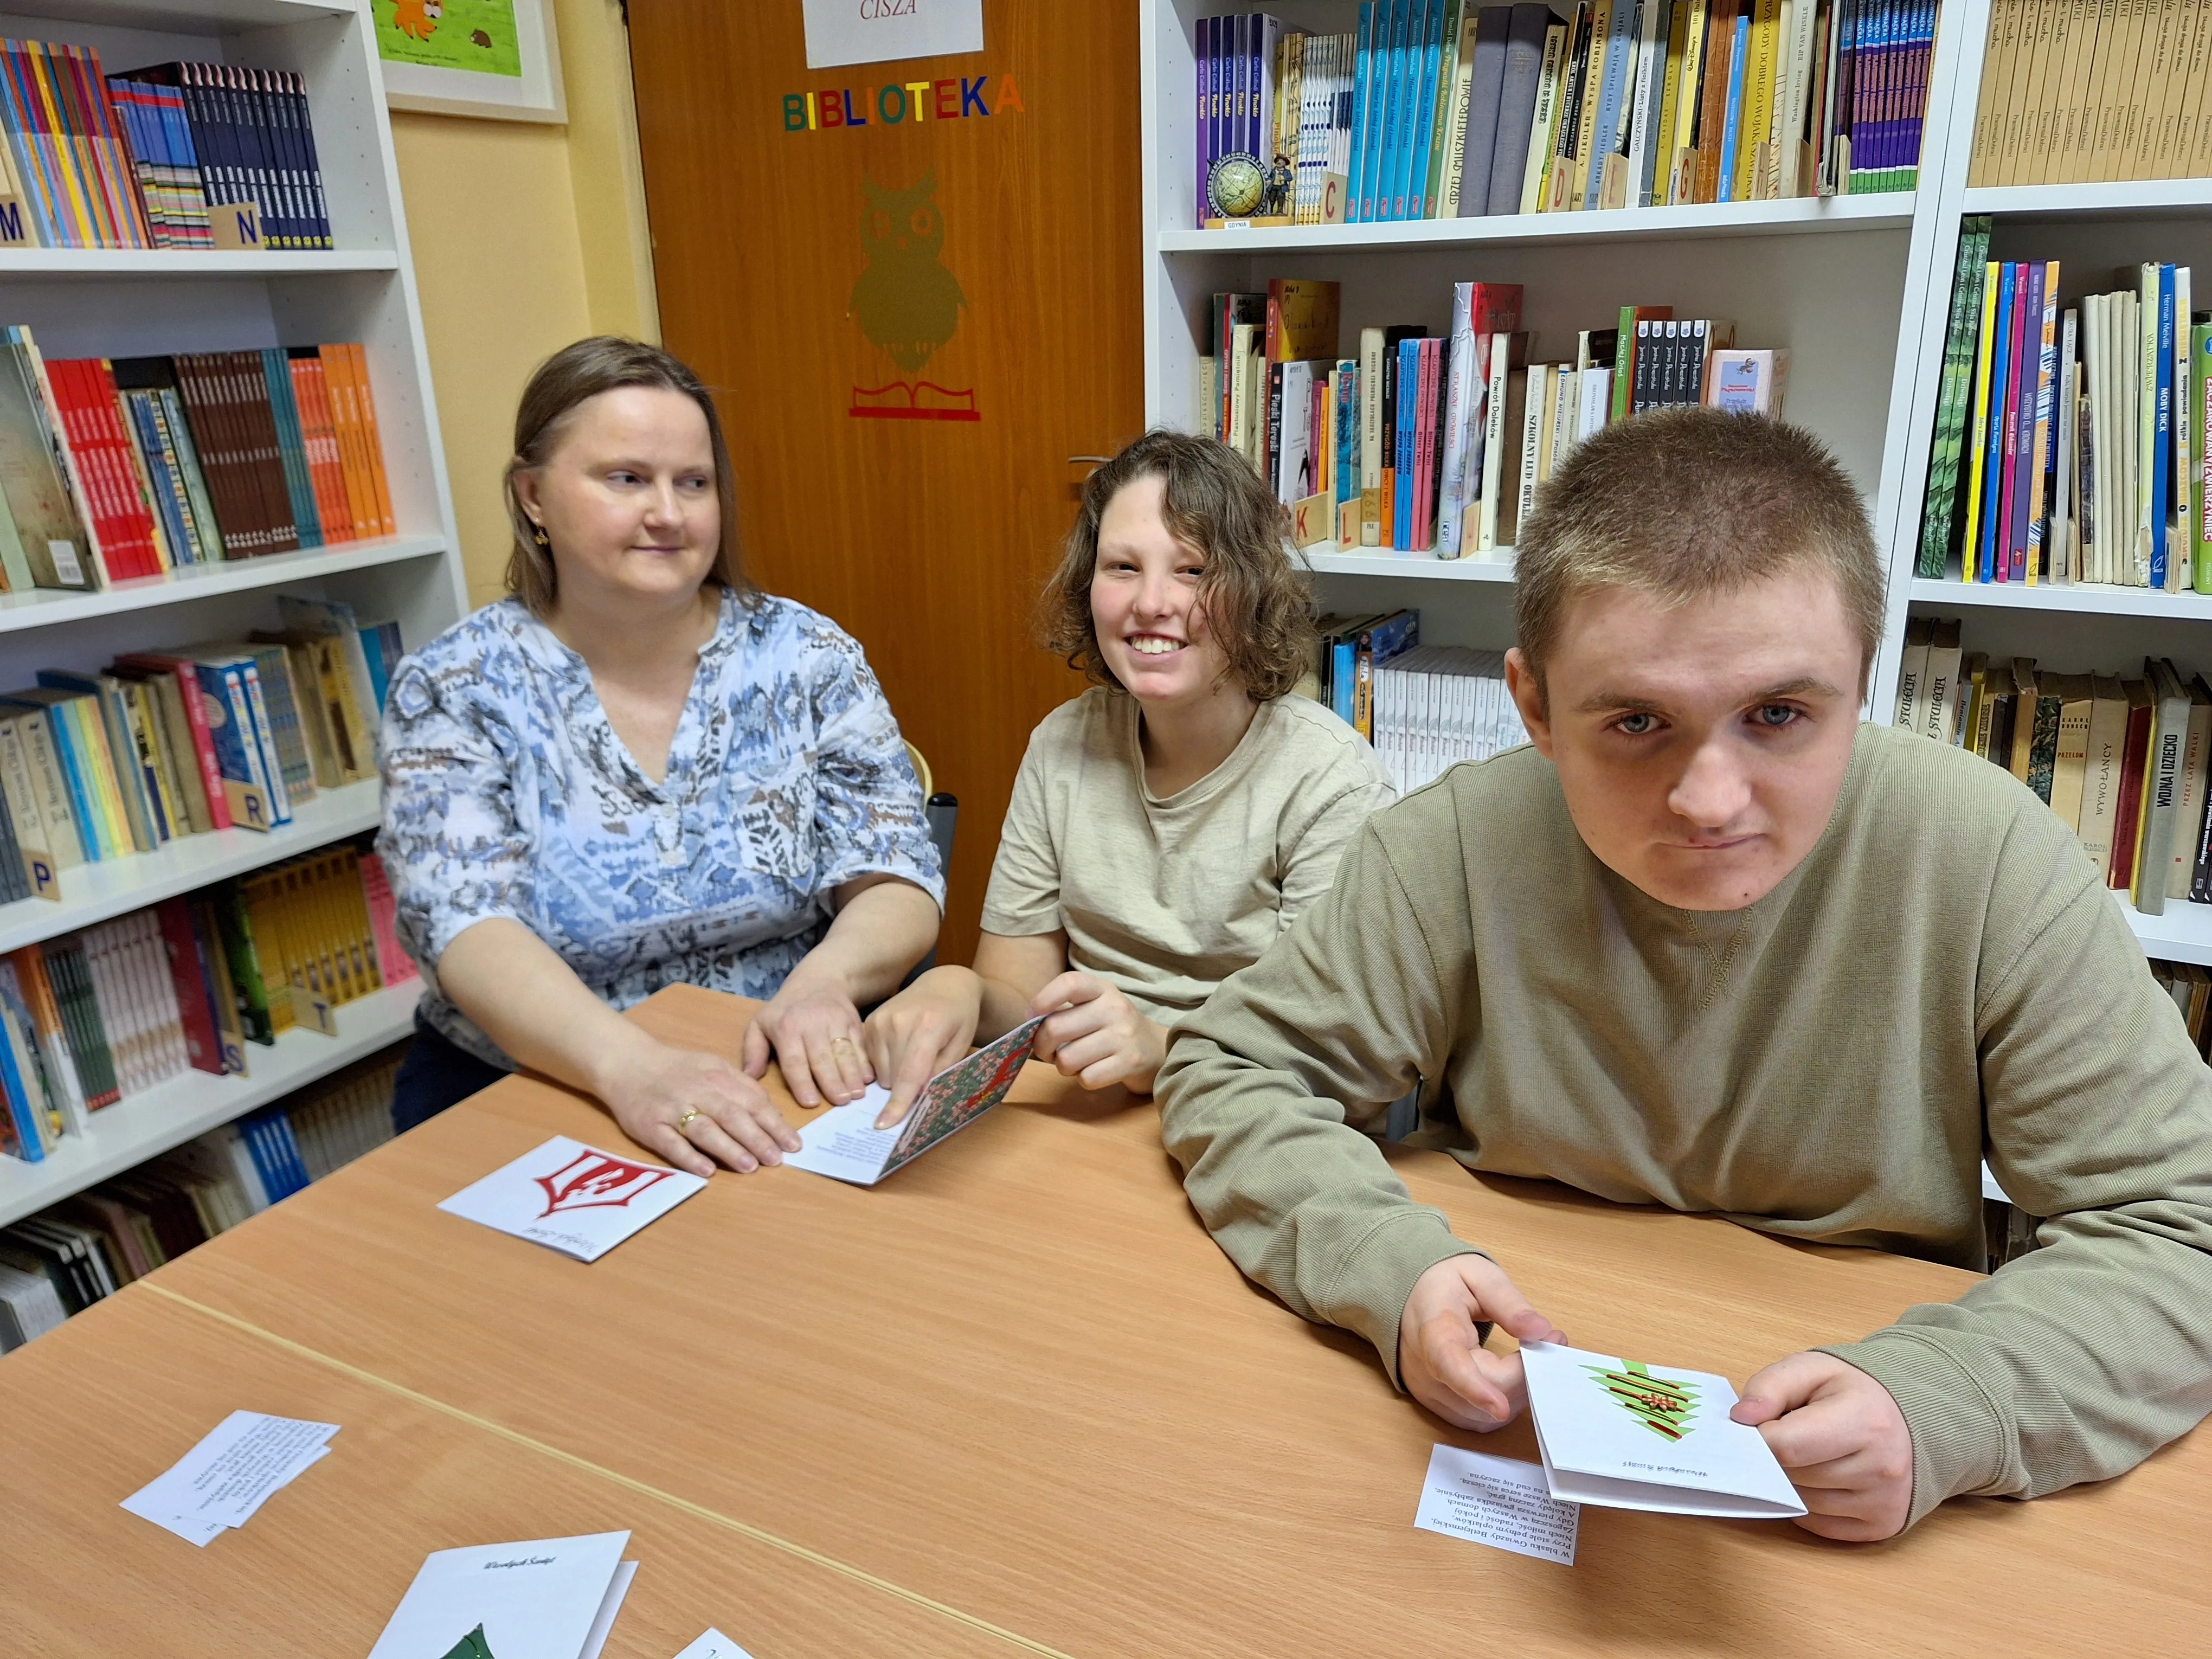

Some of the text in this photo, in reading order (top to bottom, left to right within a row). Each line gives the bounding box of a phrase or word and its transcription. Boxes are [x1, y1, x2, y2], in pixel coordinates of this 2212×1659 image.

[860, 0, 918, 20] CISZA
[1991, 24, 1999, 49] mucha
[1607, 54, 1620, 90] ŚPIEWAJĄ
[1752, 0, 1773, 146] RZYGODY DOBREGO WOJAKA
[1791, 90, 1799, 123] Washington
[1795, 70, 1803, 87] Irving
[1801, 6, 1809, 33] WINKLE
[1580, 115, 1591, 157] FIEDLER
[1587, 74, 1597, 106] WYSPA
[1592, 11, 1606, 69] ROBINSONA
[782, 74, 1024, 132] BIBLIOTEKA
[1599, 125, 1609, 156] FIEDLER
[1634, 108, 1643, 151] GAŁCZYŃSKI
[1595, 156, 1604, 184] ARKADY
[1680, 158, 1689, 199] G
[1326, 181, 1336, 218] C
[1554, 168, 1565, 207] D
[0, 203, 24, 242] M
[236, 210, 257, 245] N
[1618, 335, 1627, 357] Maciej
[2158, 294, 2171, 432] Herman Melville MOBY DICK
[1957, 378, 1968, 408] Dziwolągi
[2022, 393, 2033, 418] WSZYSTKO
[1490, 376, 1501, 439] Powrót Daleków
[1269, 394, 1280, 452] Pieski Tereski
[1526, 415, 1538, 459] SZKOLNY
[2020, 430, 2030, 454] KROWACH
[1525, 460, 1533, 479] LUD
[2202, 467, 2212, 541] ZWIERZYNIEC
[1296, 505, 1308, 538] K
[1342, 512, 1351, 544] L
[2160, 734, 2178, 770] DZIECKO
[2183, 732, 2199, 806] PRZEZ LATA WALKI
[2157, 776, 2174, 808] WOJNA
[245, 795, 262, 824] R
[33, 861, 50, 891] P
[1477, 1497, 1514, 1510] gwiazdka
[1501, 1487, 1521, 1496] serca
[1509, 1496, 1535, 1507] zaczną
[1523, 1493, 1549, 1504] Wasze
[1454, 1507, 1478, 1517] pokój
[1482, 1507, 1518, 1520] Waszych
[1517, 1507, 1554, 1520] pierwsza
[1538, 1504, 1565, 1516] kolędy
[1553, 1500, 1576, 1511] Niech
[1486, 1516, 1514, 1526] radość
[1496, 1526, 1527, 1537] pełnym
[1516, 1522, 1546, 1534] miłość,
[1532, 1517, 1573, 1534] Zagoszczą
[1557, 1516, 1574, 1526] Gdy
[1490, 1533, 1527, 1547] Gwiazdy
[1529, 1534, 1549, 1543] stole
[1531, 1543, 1558, 1555] blasku
[1548, 1531, 1572, 1542] Niech
[1552, 1539, 1571, 1549] Przy
[1561, 1550, 1570, 1558] W
